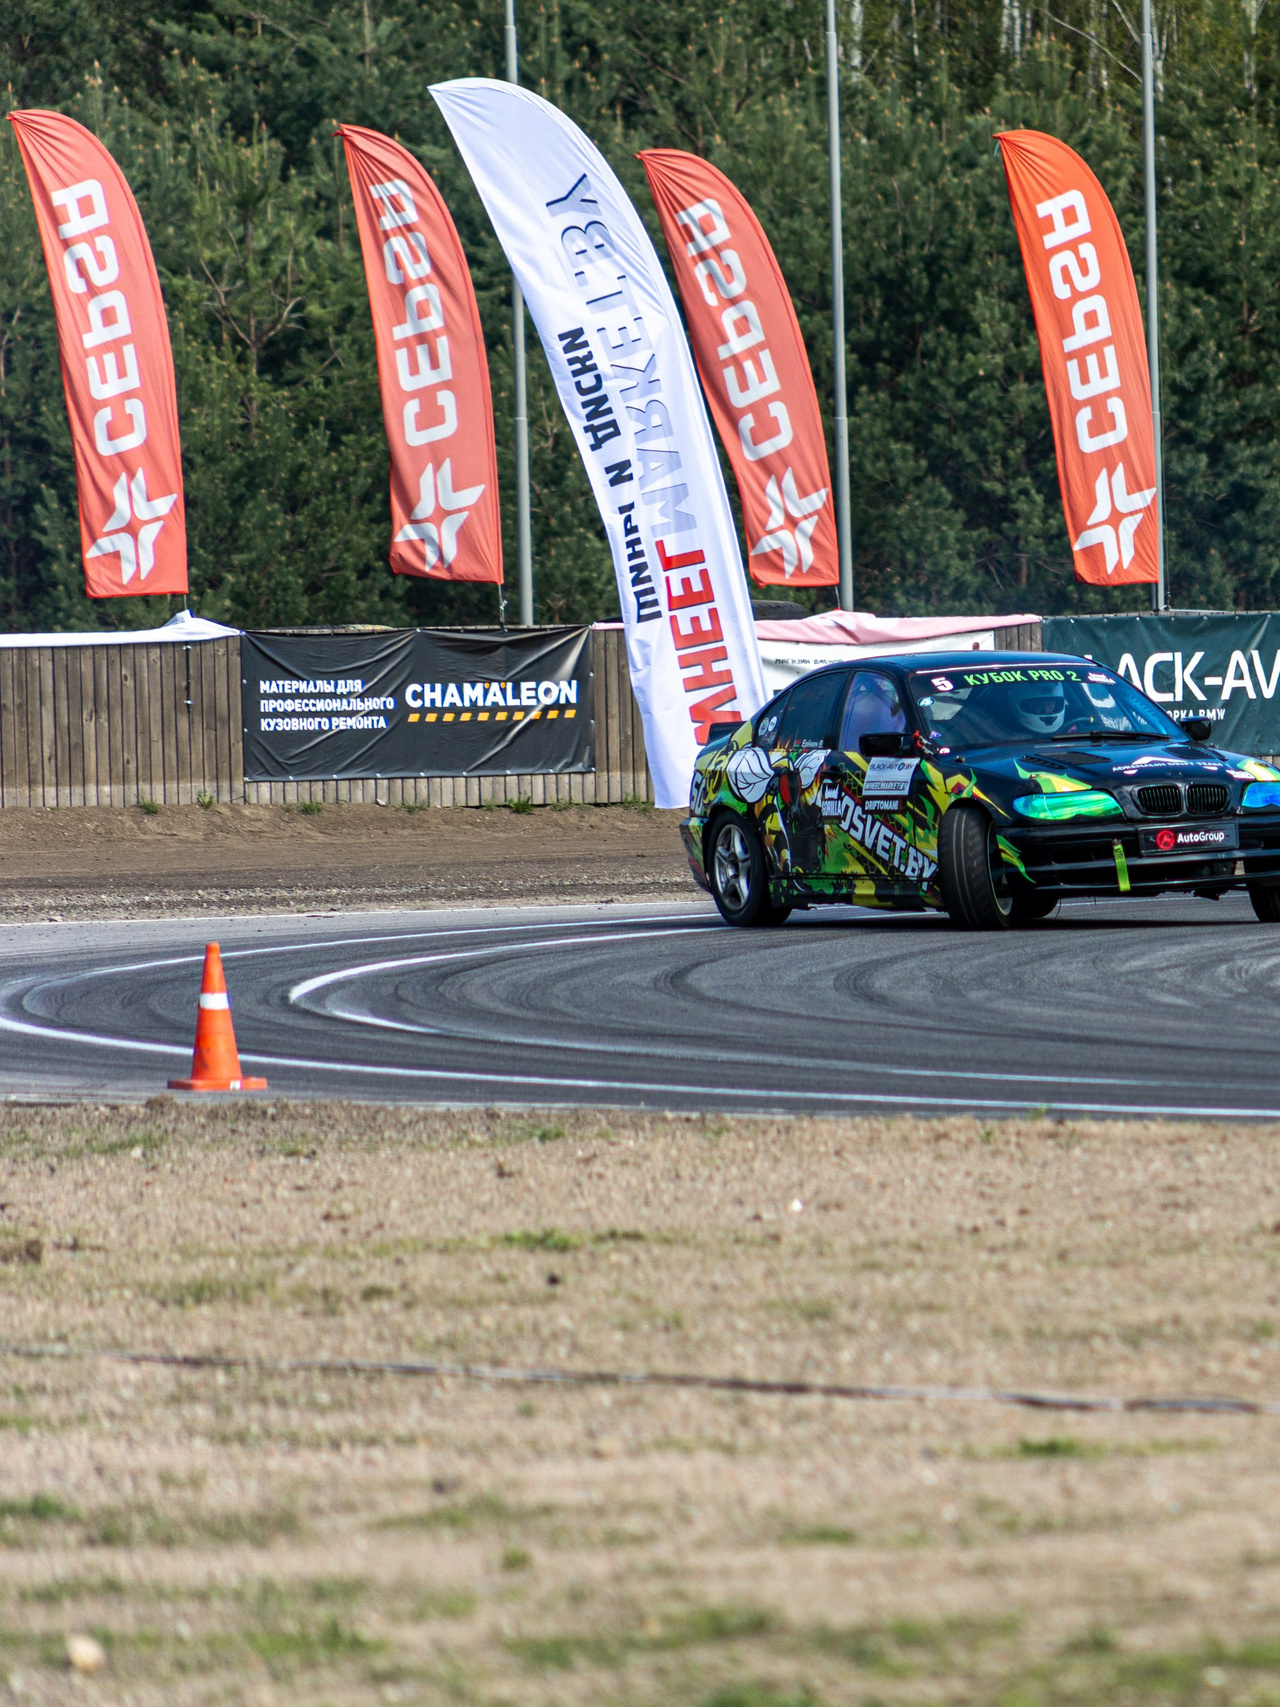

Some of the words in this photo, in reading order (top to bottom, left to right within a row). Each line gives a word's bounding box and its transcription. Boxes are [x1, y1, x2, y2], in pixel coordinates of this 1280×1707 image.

[930, 676, 954, 692] 5
[963, 670, 1028, 686] КУБОК
[1027, 670, 1064, 682] PRO
[1067, 670, 1082, 682] 2
[259, 680, 336, 694] МАТЕРИАЛЫ
[336, 679, 363, 695] ДЛЯ
[260, 697, 395, 712] ПРОФЕССИОНАЛЬНОГО
[260, 717, 330, 731] КУЗОВНОГО
[332, 716, 387, 730] РЕМОНТА
[1176, 831, 1225, 844] AutoGroup
